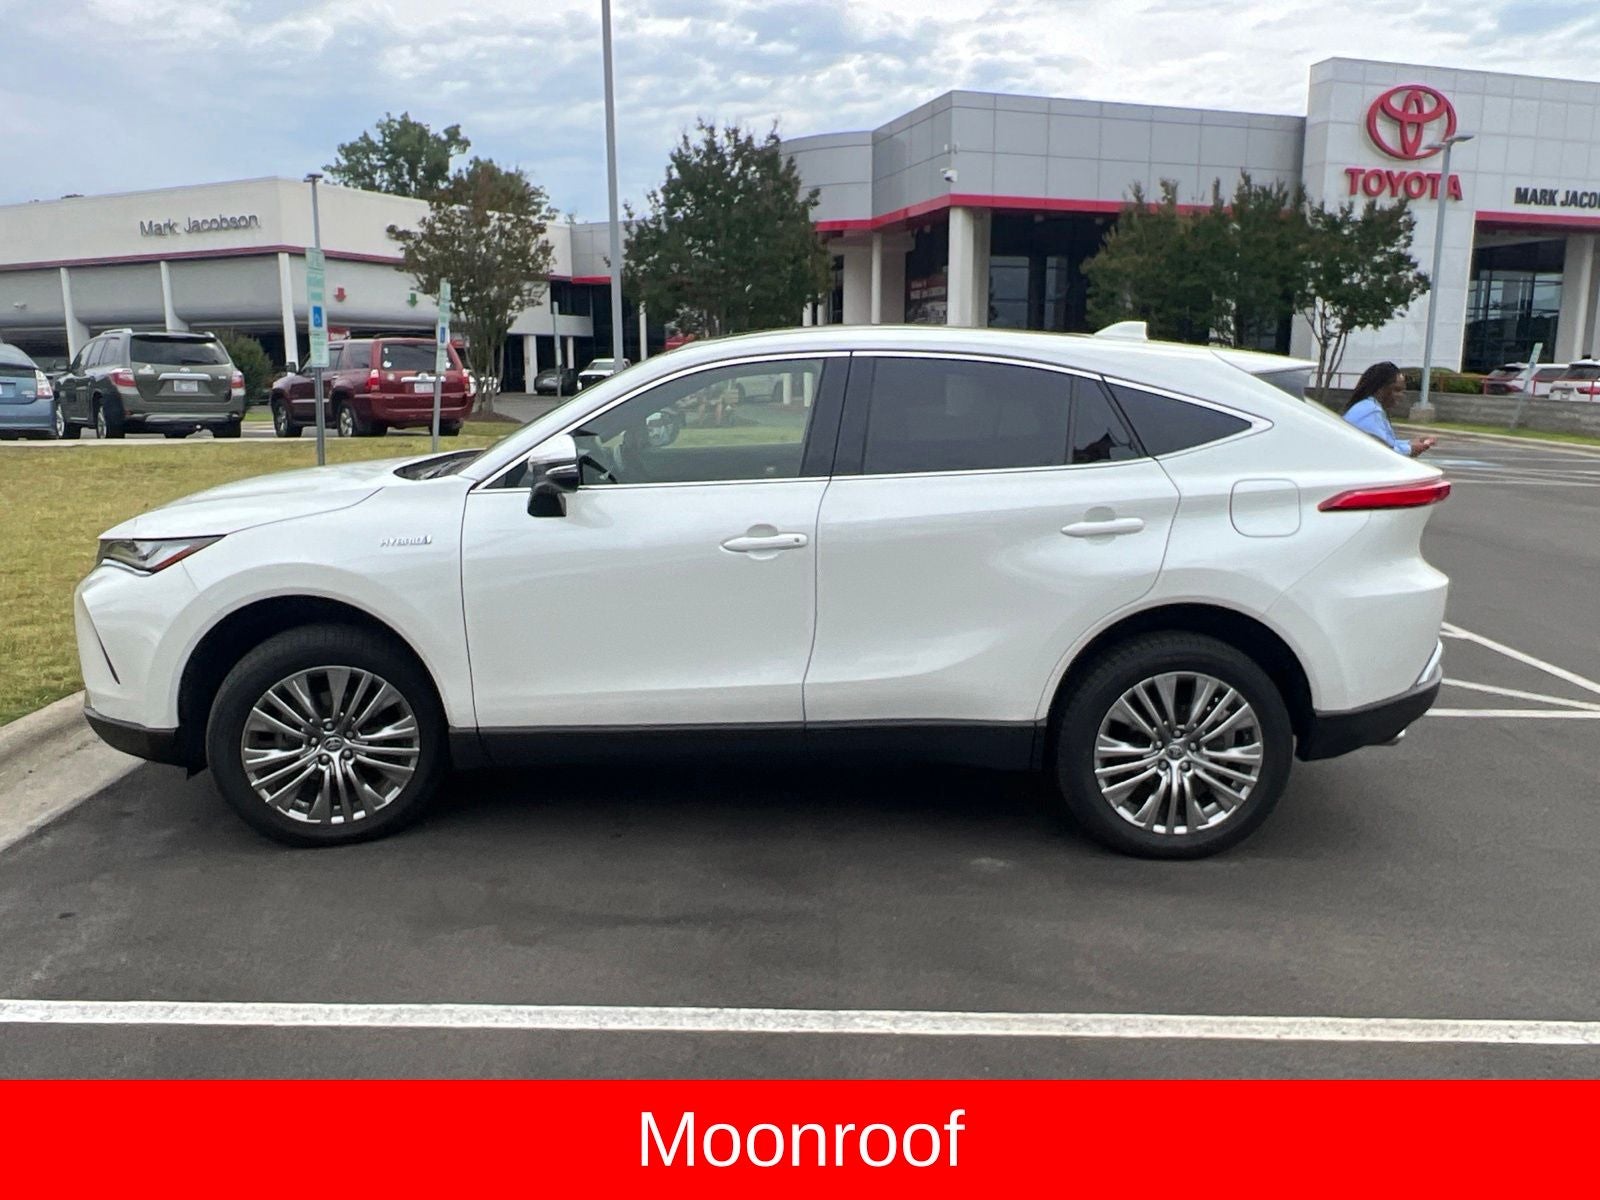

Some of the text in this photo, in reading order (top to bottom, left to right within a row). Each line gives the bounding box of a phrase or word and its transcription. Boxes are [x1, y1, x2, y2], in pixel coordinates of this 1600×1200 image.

[1345, 167, 1463, 201] TOYOTA
[1514, 186, 1559, 206] MARK
[140, 214, 259, 236] Mark Jacobson
